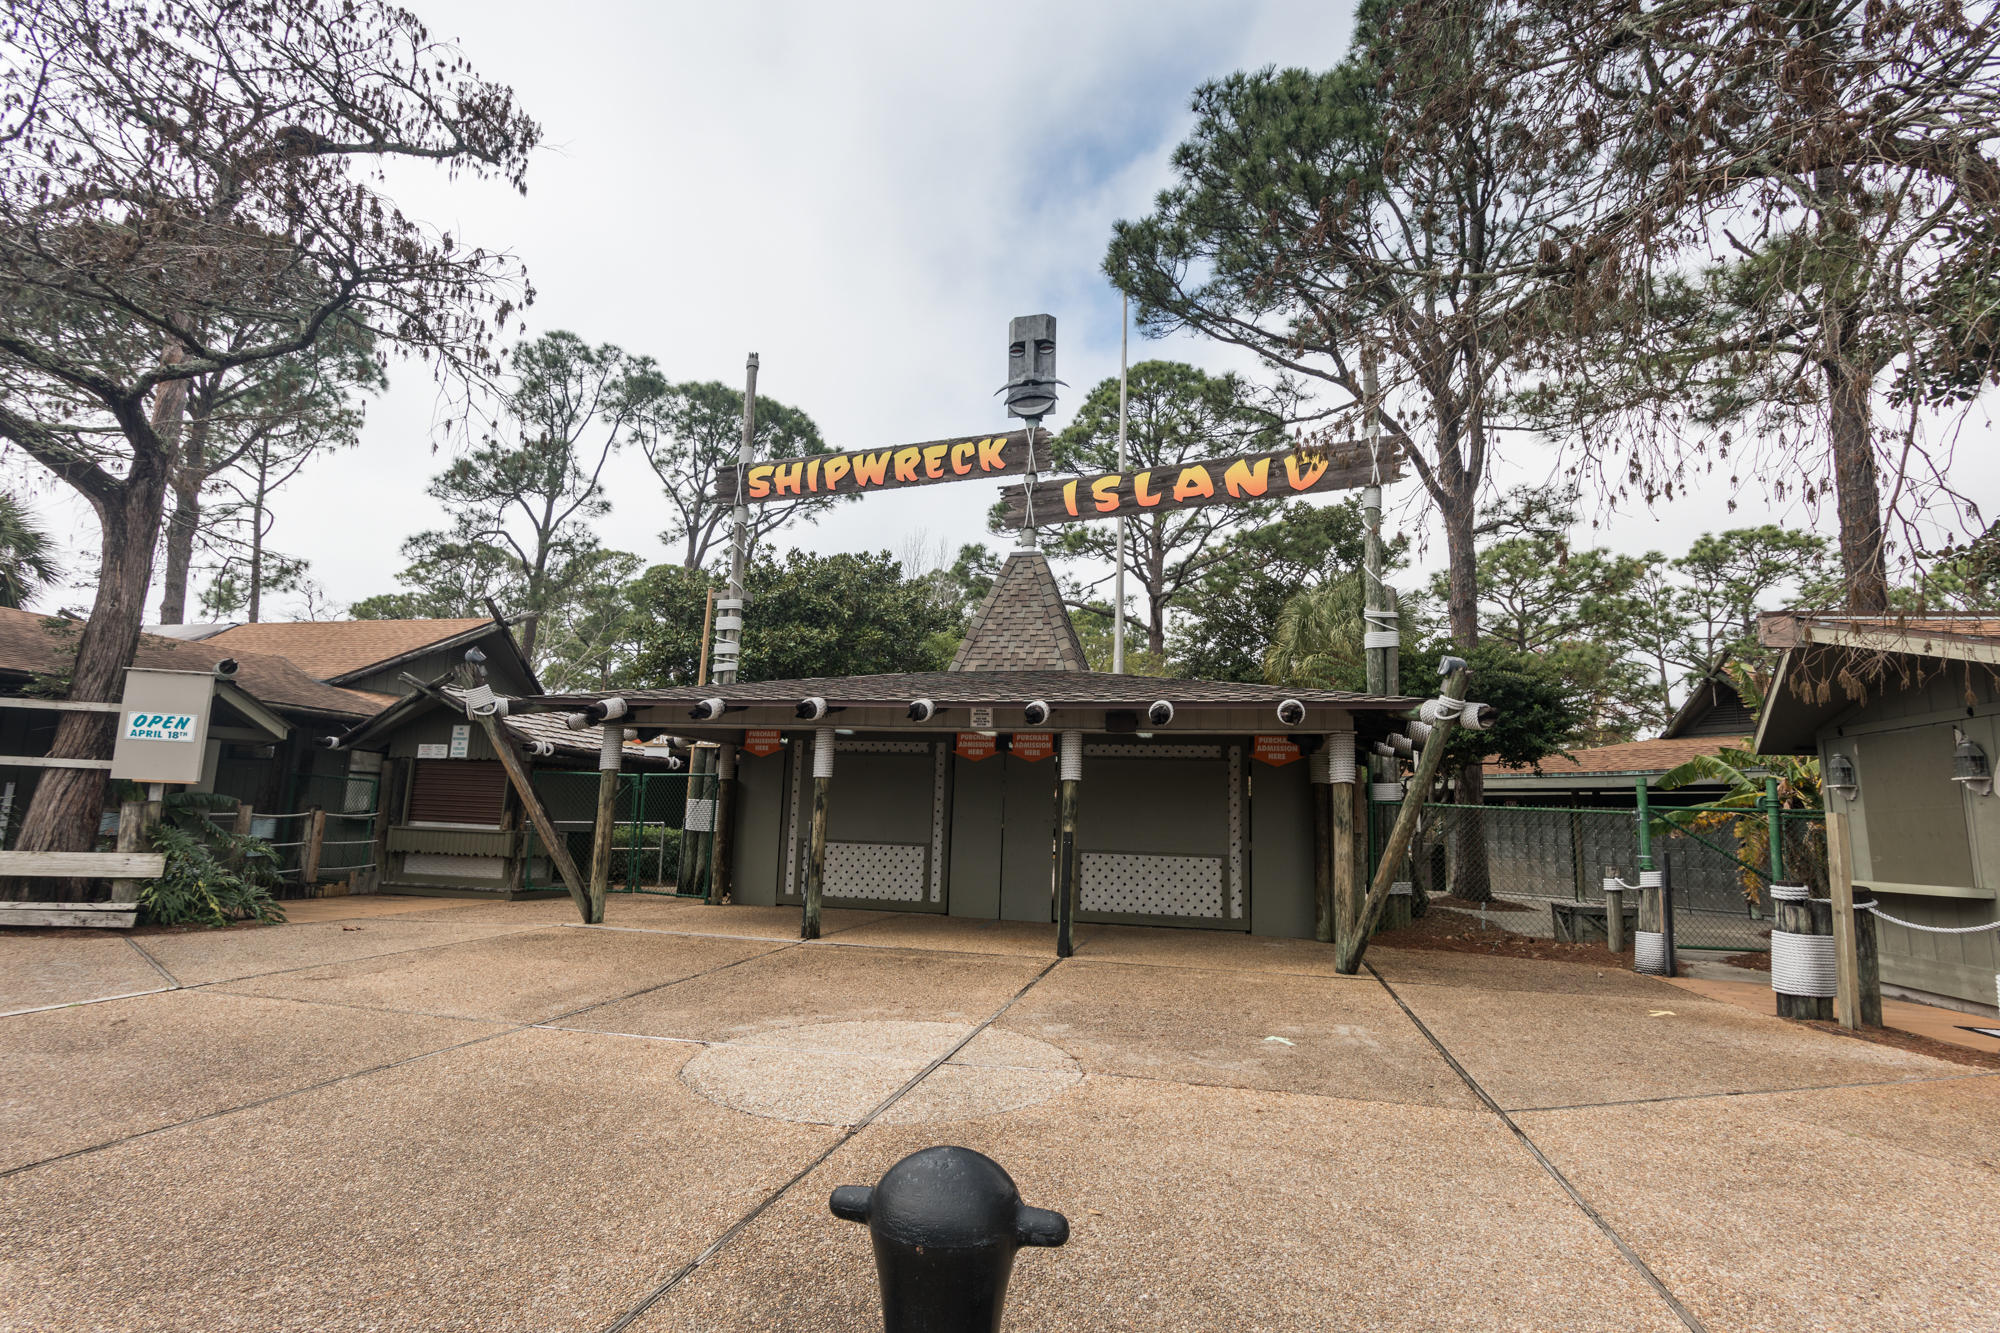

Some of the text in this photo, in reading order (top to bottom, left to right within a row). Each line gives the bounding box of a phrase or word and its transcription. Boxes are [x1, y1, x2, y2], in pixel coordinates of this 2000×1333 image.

[748, 438, 1008, 498] SHIPWRECK
[1062, 449, 1330, 517] ISLAND
[130, 729, 163, 738] APRIL
[133, 715, 191, 730] OPEN
